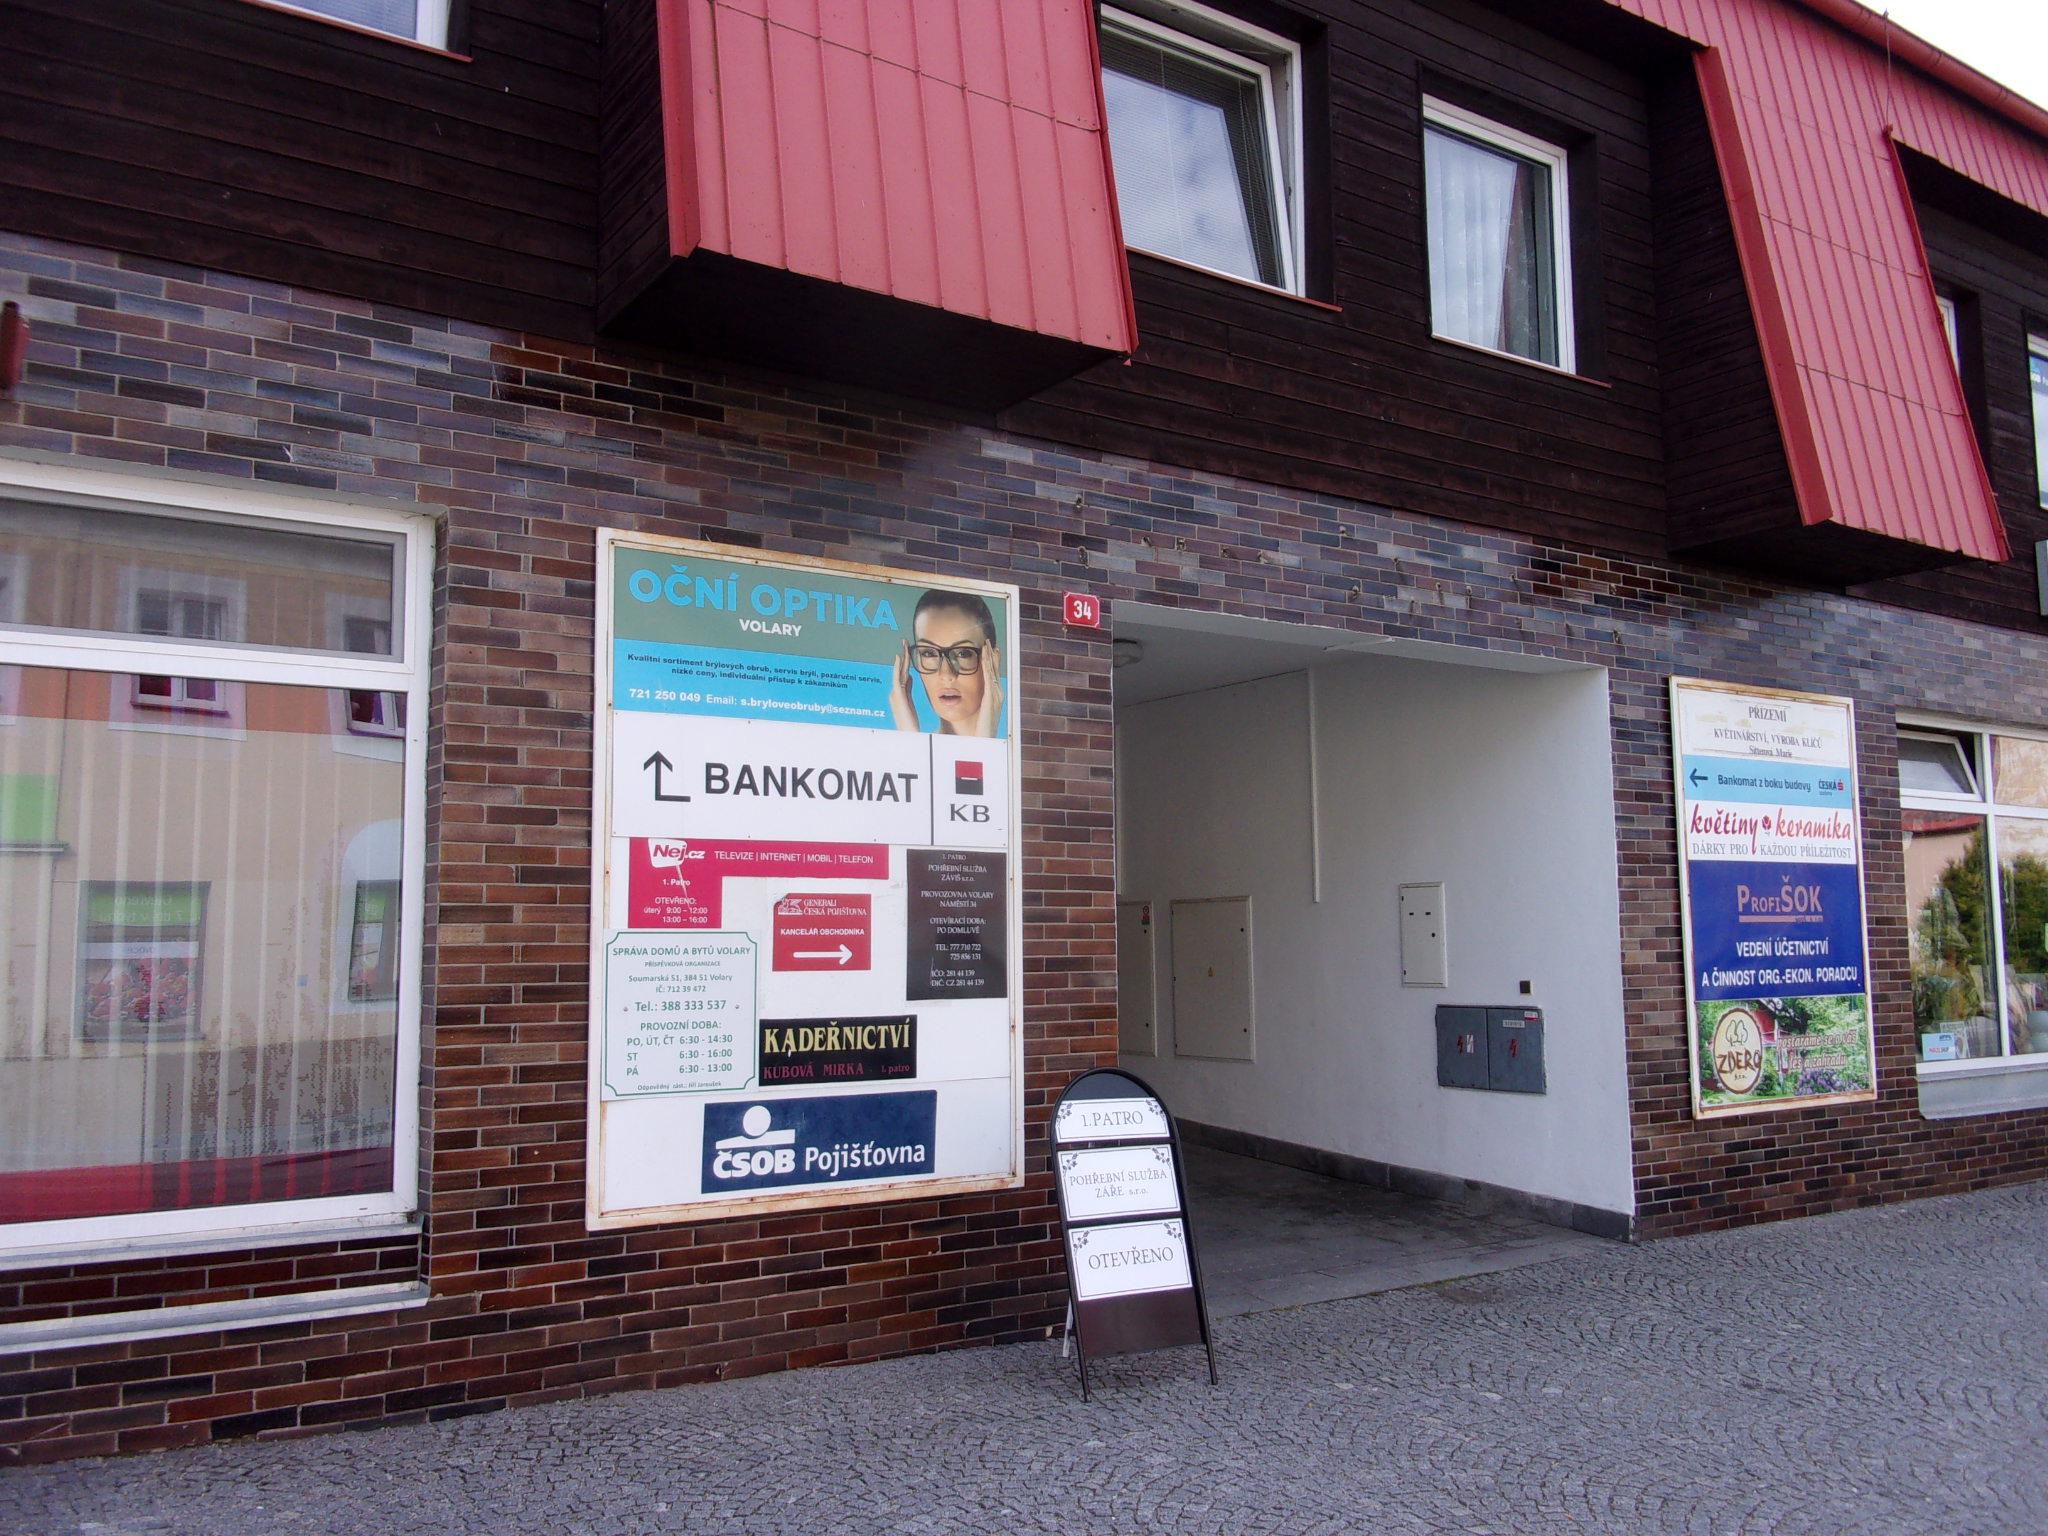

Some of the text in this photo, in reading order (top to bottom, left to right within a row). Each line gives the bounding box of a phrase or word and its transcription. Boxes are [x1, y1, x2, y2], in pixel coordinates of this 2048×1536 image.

[629, 564, 899, 631] OČNÍ OPTIKA
[1073, 600, 1092, 620] 34
[739, 618, 802, 637] VOLARY
[662, 656, 703, 667] sortiment
[705, 659, 745, 670] brýlových
[746, 664, 773, 673] obrub,
[774, 667, 798, 675] servis
[858, 676, 883, 684] servis,
[719, 671, 766, 681] individuální
[768, 675, 796, 685] přístup
[629, 688, 887, 718] 721 250 049 Email: s.bryloveobruby@seznam.cz
[1748, 705, 1787, 722] PŘÍZEMÍ
[705, 761, 919, 803] BANKOMAT
[1718, 774, 1757, 788] Bankomat
[1764, 779, 1783, 789] boku
[1785, 780, 1811, 792] budovy
[950, 803, 991, 823] KB
[1690, 803, 1851, 855] květiny keramika
[653, 844, 706, 861] Nej.cz
[714, 850, 874, 864] TELEVIZE INTERNET MOBIL TELEFON
[1692, 840, 1852, 859] DÁRKY PRO KAŽDOU PŘÍLEŽITOST
[803, 899, 837, 907] GENERALI
[921, 890, 994, 899] PROVOZOVNA VOLARY
[803, 906, 867, 916] ČESKÁ POJIŠŤOVNA
[780, 927, 818, 935] KANCELÁŘ
[612, 944, 751, 956] SPRÁVA DOMŮ A BYTŮ VOLARY
[1736, 937, 1829, 957] VEDENÍ ÚČETNICTVÍ
[628, 974, 669, 983] Soumarská
[684, 974, 698, 982] 384
[709, 973, 733, 983] Volary
[1701, 972, 1709, 987] A
[1712, 967, 1756, 987] ČINNOST
[1758, 968, 1814, 985] ORG.-EKON.
[693, 985, 707, 993] 472
[635, 999, 727, 1012] Tel.: 388 333 537
[640, 1020, 722, 1031] PROVOZNÍ DOBA:
[627, 1037, 643, 1047] PO,
[663, 1034, 675, 1045] ČT
[679, 1036, 700, 1045] 6:30
[708, 1034, 733, 1043] 14:30
[764, 1018, 910, 1054] KADEŘNICTVÍ
[627, 1048, 733, 1061] ST 6:30 16:00
[626, 1063, 733, 1076] PÁ 6:30 13:00
[763, 1062, 815, 1080] KUBOVÁ
[823, 1062, 865, 1076] MIRKA
[888, 1063, 911, 1075] patro
[712, 1140, 926, 1180] ČSOB Pojišťovna
[1069, 1167, 1169, 1187] POHŘEBNÍ SLUŽBA
[1088, 1246, 1174, 1270] OTEVŘENO
